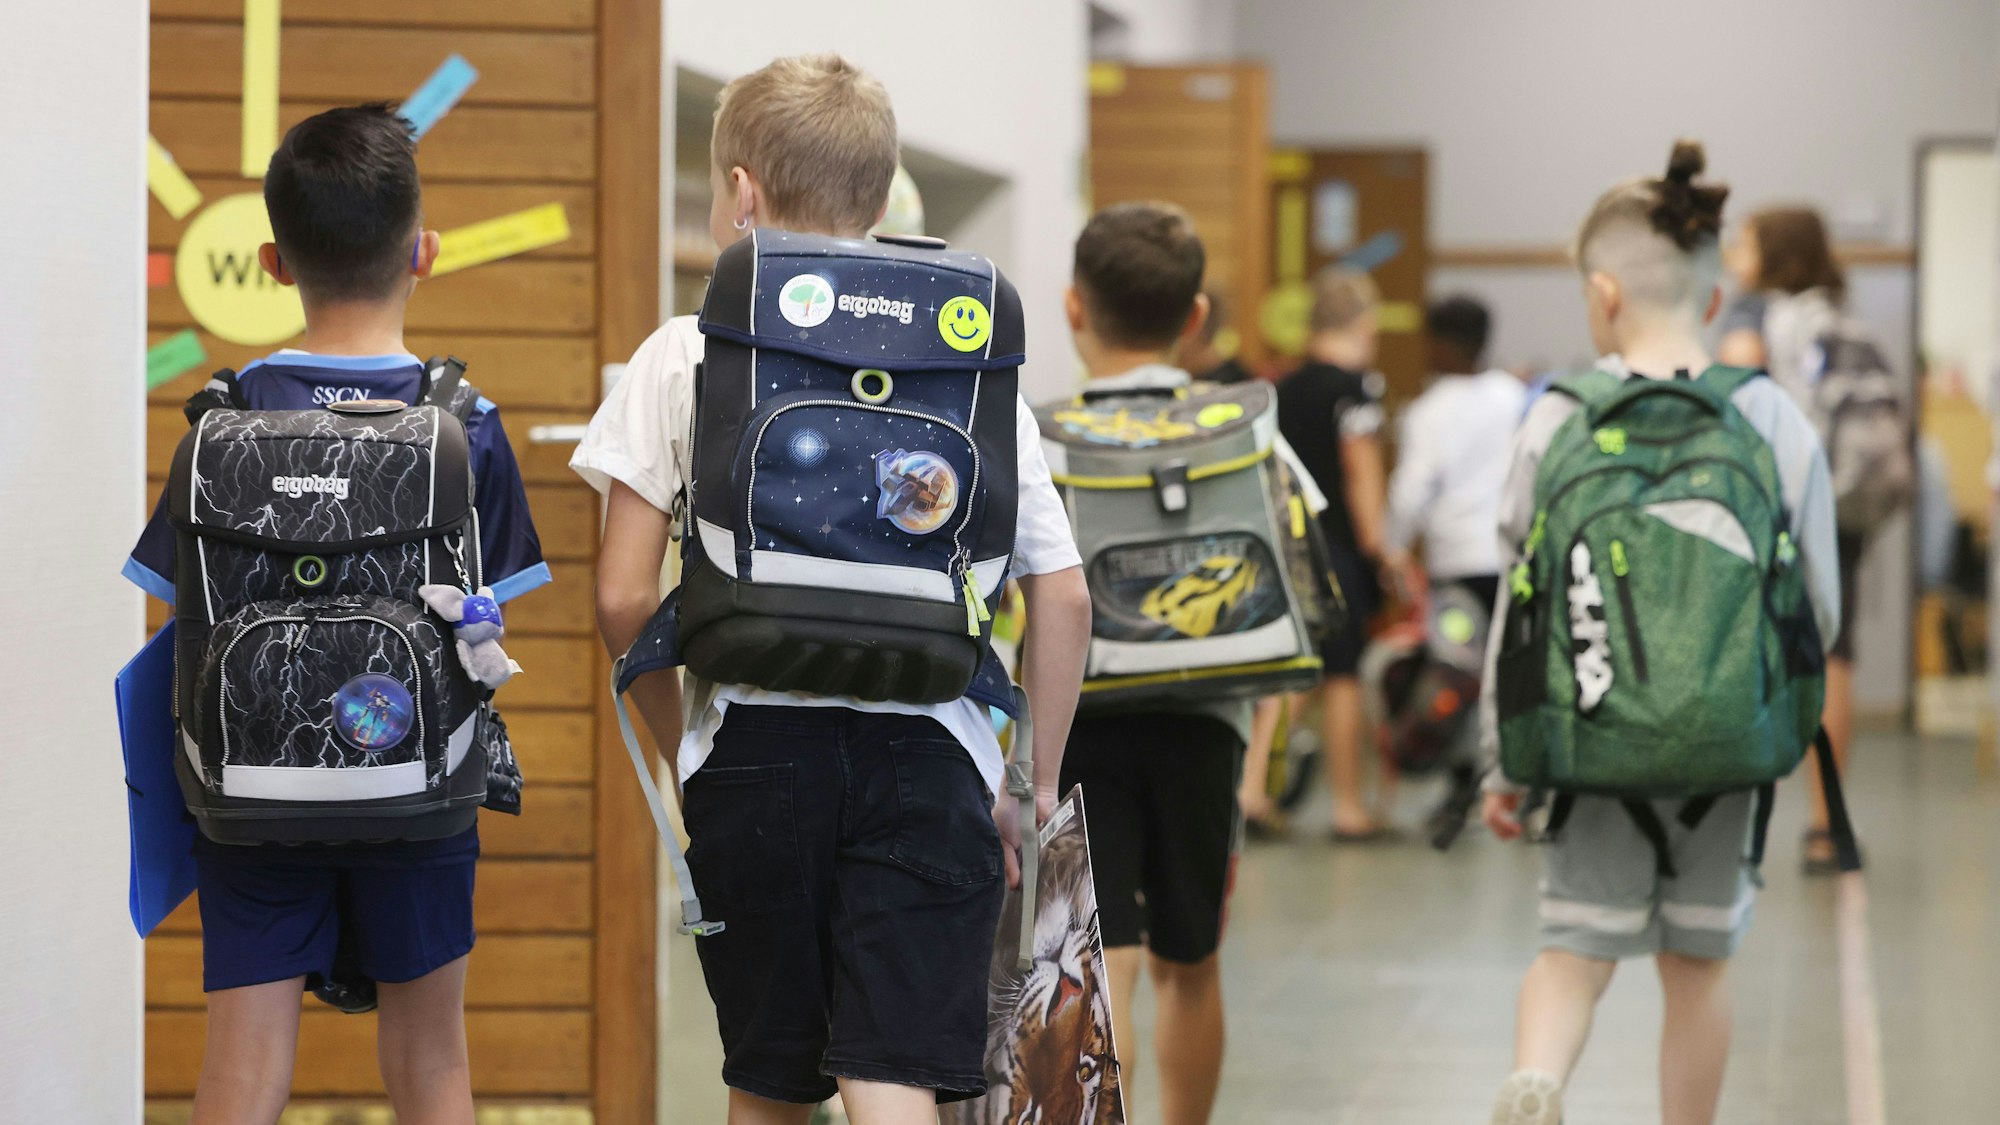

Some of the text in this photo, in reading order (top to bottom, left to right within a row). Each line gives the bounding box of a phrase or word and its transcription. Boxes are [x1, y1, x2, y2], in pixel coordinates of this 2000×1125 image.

[206, 251, 279, 287] WI
[838, 294, 915, 324] ergobag
[312, 385, 371, 405] SSCN
[272, 474, 350, 500] ergobag
